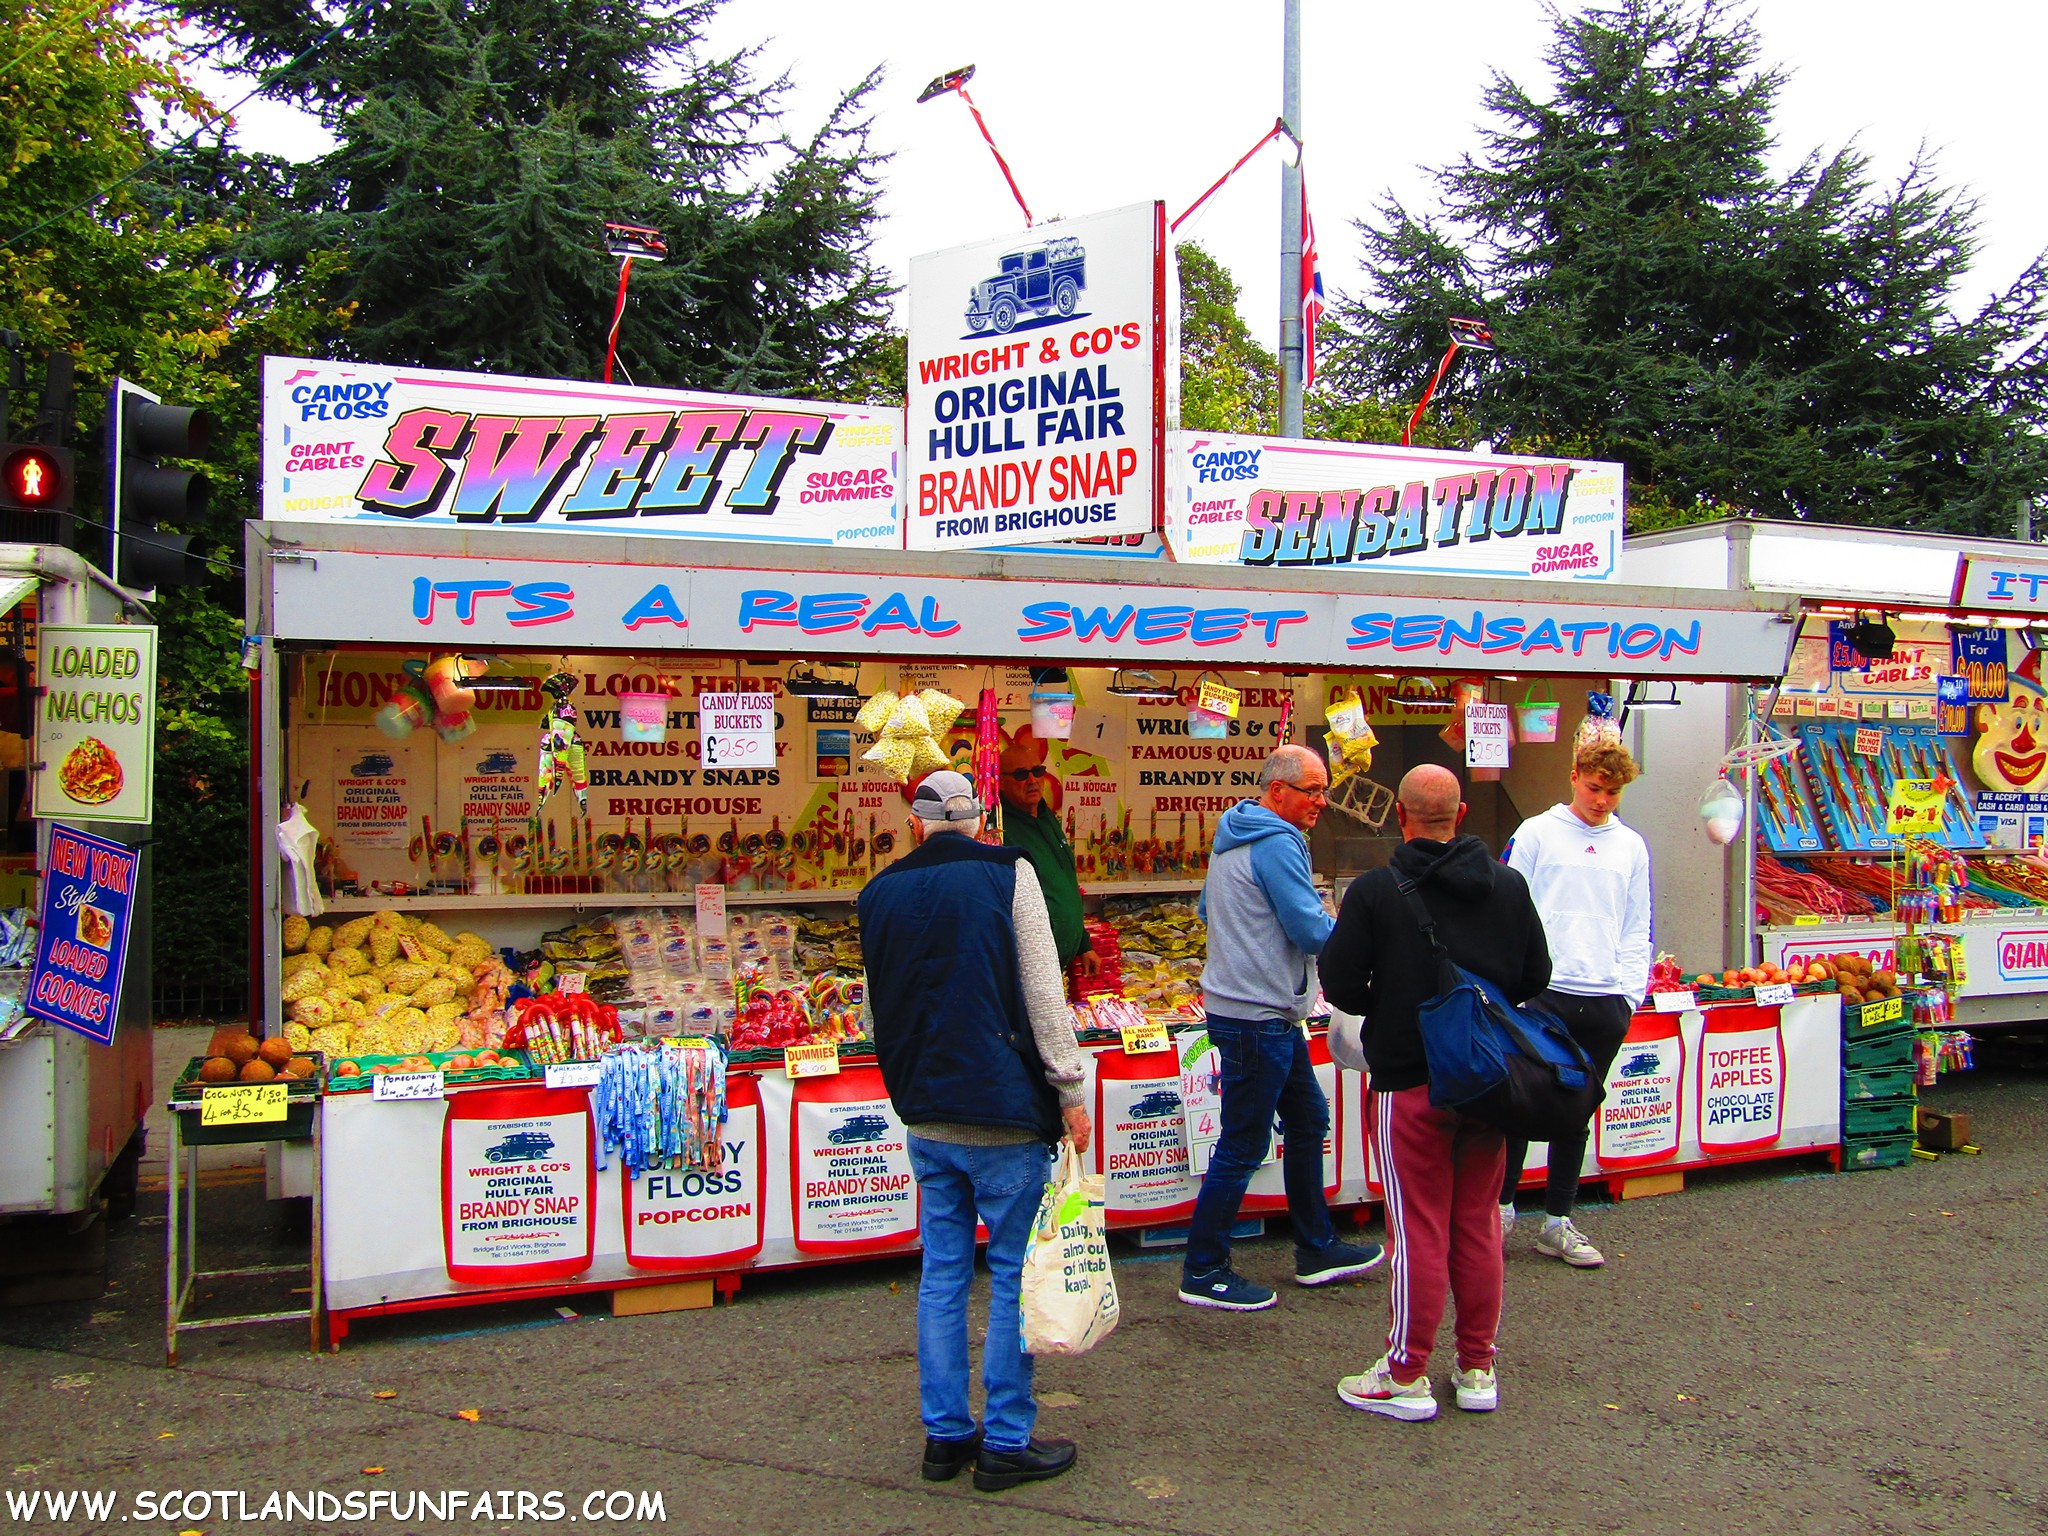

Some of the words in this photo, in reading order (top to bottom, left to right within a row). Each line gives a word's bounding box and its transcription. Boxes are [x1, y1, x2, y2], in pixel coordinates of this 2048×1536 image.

[919, 342, 1030, 384] WRIGHT
[1038, 336, 1060, 364] &
[1069, 322, 1141, 358] CO'S
[291, 381, 393, 404] CANDY
[934, 364, 1120, 424] ORIGINAL
[301, 400, 389, 422] FLOSS
[834, 424, 893, 437] CINDER
[928, 416, 1026, 462] HULL
[1037, 401, 1125, 447] FAIR
[290, 441, 355, 458] GIANT
[836, 436, 893, 448] TOFFEE
[285, 455, 365, 473] CABLES
[355, 406, 835, 523] SWEET
[1192, 449, 1262, 469] CANDY
[806, 468, 888, 489] SUGAR
[1199, 464, 1260, 483] FLOSS
[919, 458, 1042, 517] BRANDY
[1048, 447, 1137, 503] SNAP
[1573, 476, 1615, 488] CINDER
[800, 484, 894, 504] DUMMIES
[1575, 486, 1615, 497] TOFFEE
[284, 494, 353, 512] NOUGAT
[1191, 498, 1236, 513] GIANT
[936, 516, 989, 538] FROM
[994, 502, 1116, 533] BRIGHOUSE
[1188, 508, 1243, 525] CABLES
[1239, 463, 1575, 566] SENSATION
[1572, 512, 1615, 525] POPCORN
[836, 525, 895, 541] POPCORN
[1188, 543, 1237, 558] NOUGAT
[1535, 541, 1595, 561] SUGAR
[1531, 555, 1599, 574] DUMMIES
[621, 583, 689, 631] A
[738, 589, 962, 637] REAL
[1017, 601, 1309, 648] SWEET
[1346, 610, 1701, 663] SENSATION
[1970, 644, 1989, 655] For
[51, 645, 142, 681] LOADED
[1863, 665, 1932, 685] CABLES
[583, 673, 682, 697] LOOK
[1204, 691, 1234, 704] BUCKETS
[1222, 689, 1240, 700] FLOSS
[47, 690, 144, 726] NACHOS
[701, 696, 738, 711] CANDY
[741, 696, 773, 710] FLOSS
[816, 698, 835, 708] WE
[812, 710, 843, 720] CASH
[1466, 705, 1487, 719] CANDY
[1488, 705, 1507, 720] FLOSS
[714, 715, 762, 729] BUCKETS
[1473, 721, 1501, 735] BUCKETS
[1857, 730, 1880, 738] PLEASE
[1857, 736, 1866, 745] DO
[1866, 738, 1880, 746] NOT
[706, 735, 759, 763] £2.50
[1131, 745, 1212, 760] FAMOUS
[1857, 744, 1878, 754] TOUCH
[385, 778, 407, 786] CO'S
[464, 776, 499, 784] WRIGHT
[588, 770, 697, 786] BRANDY
[702, 769, 780, 786] SNAPS
[1139, 771, 1225, 786] BRANDY
[345, 787, 399, 796] ORIGINAL
[471, 784, 522, 793] ORIGINAL
[841, 782, 859, 793] ALL
[861, 781, 900, 793] NOUGAT
[1065, 781, 1080, 792] ALL
[1083, 782, 1117, 793] NOUGAT
[343, 796, 374, 804] HULL
[376, 795, 401, 803] FAIR
[469, 793, 499, 801] HULL
[500, 792, 524, 800] FAIR
[858, 797, 883, 808] BARS
[1080, 796, 1102, 807] BARS
[1982, 793, 1994, 801] WE
[1994, 793, 2022, 802] ACCEPT
[337, 805, 379, 820] BRANDY
[380, 805, 408, 820] SNAP
[463, 802, 502, 817] BRANDY
[503, 802, 531, 816] SNAP
[607, 797, 762, 815] BRIGHOUSE
[1977, 802, 1996, 810] CASH
[2004, 803, 2024, 811] CARD
[52, 835, 88, 880] NEW
[89, 848, 132, 896] YORK
[54, 881, 98, 921] Style
[48, 937, 109, 980] LOADED
[36, 971, 111, 1024] COOKIES
[1136, 1032, 1155, 1040] BARS
[1137, 1026, 1164, 1034] NOUGAT
[787, 1046, 836, 1062] DUMMIES
[1708, 1046, 1771, 1069] TOFFEE
[1610, 1078, 1642, 1089] WRIGHT
[1652, 1076, 1671, 1085] CO'S
[1709, 1067, 1773, 1089] APPLES
[1621, 1086, 1660, 1097] ORIGINAL
[1620, 1096, 1642, 1106] HULL
[1643, 1094, 1661, 1104] FAIR
[1707, 1091, 1775, 1109] CHOCOLATE
[203, 1103, 218, 1122] 4
[1605, 1105, 1648, 1123] BRANDY
[1648, 1101, 1673, 1118] SNAP
[1708, 1104, 1772, 1126] APPLES
[1116, 1120, 1158, 1132] WRIGHT
[1198, 1112, 1215, 1135] 4
[1606, 1121, 1628, 1132] FROM
[1630, 1116, 1672, 1129] BRIGHOUSE
[1130, 1129, 1178, 1141] ORIGINAL
[813, 1146, 862, 1157] WRIGHT
[876, 1142, 903, 1153] CO'S
[1128, 1140, 1157, 1151] HULL
[1159, 1137, 1179, 1148] FAIR
[829, 1155, 887, 1168] ORIGINAL
[1109, 1150, 1163, 1170] BRANDY
[468, 1165, 523, 1177] WRIGHT
[540, 1162, 571, 1172] CO'S
[827, 1168, 860, 1178] HULL
[862, 1166, 888, 1176] FAIR
[1111, 1168, 1139, 1180] FROM
[487, 1175, 552, 1188] ORIGINAL
[647, 1169, 743, 1200] FLOSS
[806, 1178, 867, 1198] BRANDY
[870, 1174, 911, 1193] SNAP
[485, 1188, 521, 1199] HULL
[524, 1186, 554, 1196] FAIR
[459, 1198, 530, 1220] BRANDY
[533, 1196, 579, 1214] SNAP
[807, 1198, 840, 1209] FROM
[842, 1192, 909, 1206] BRIGHOUSE
[637, 1202, 752, 1226] POPCORN
[461, 1220, 499, 1231] FROM
[502, 1216, 577, 1228] BRIGHOUSE
[534, 1241, 567, 1249] Brighouse
